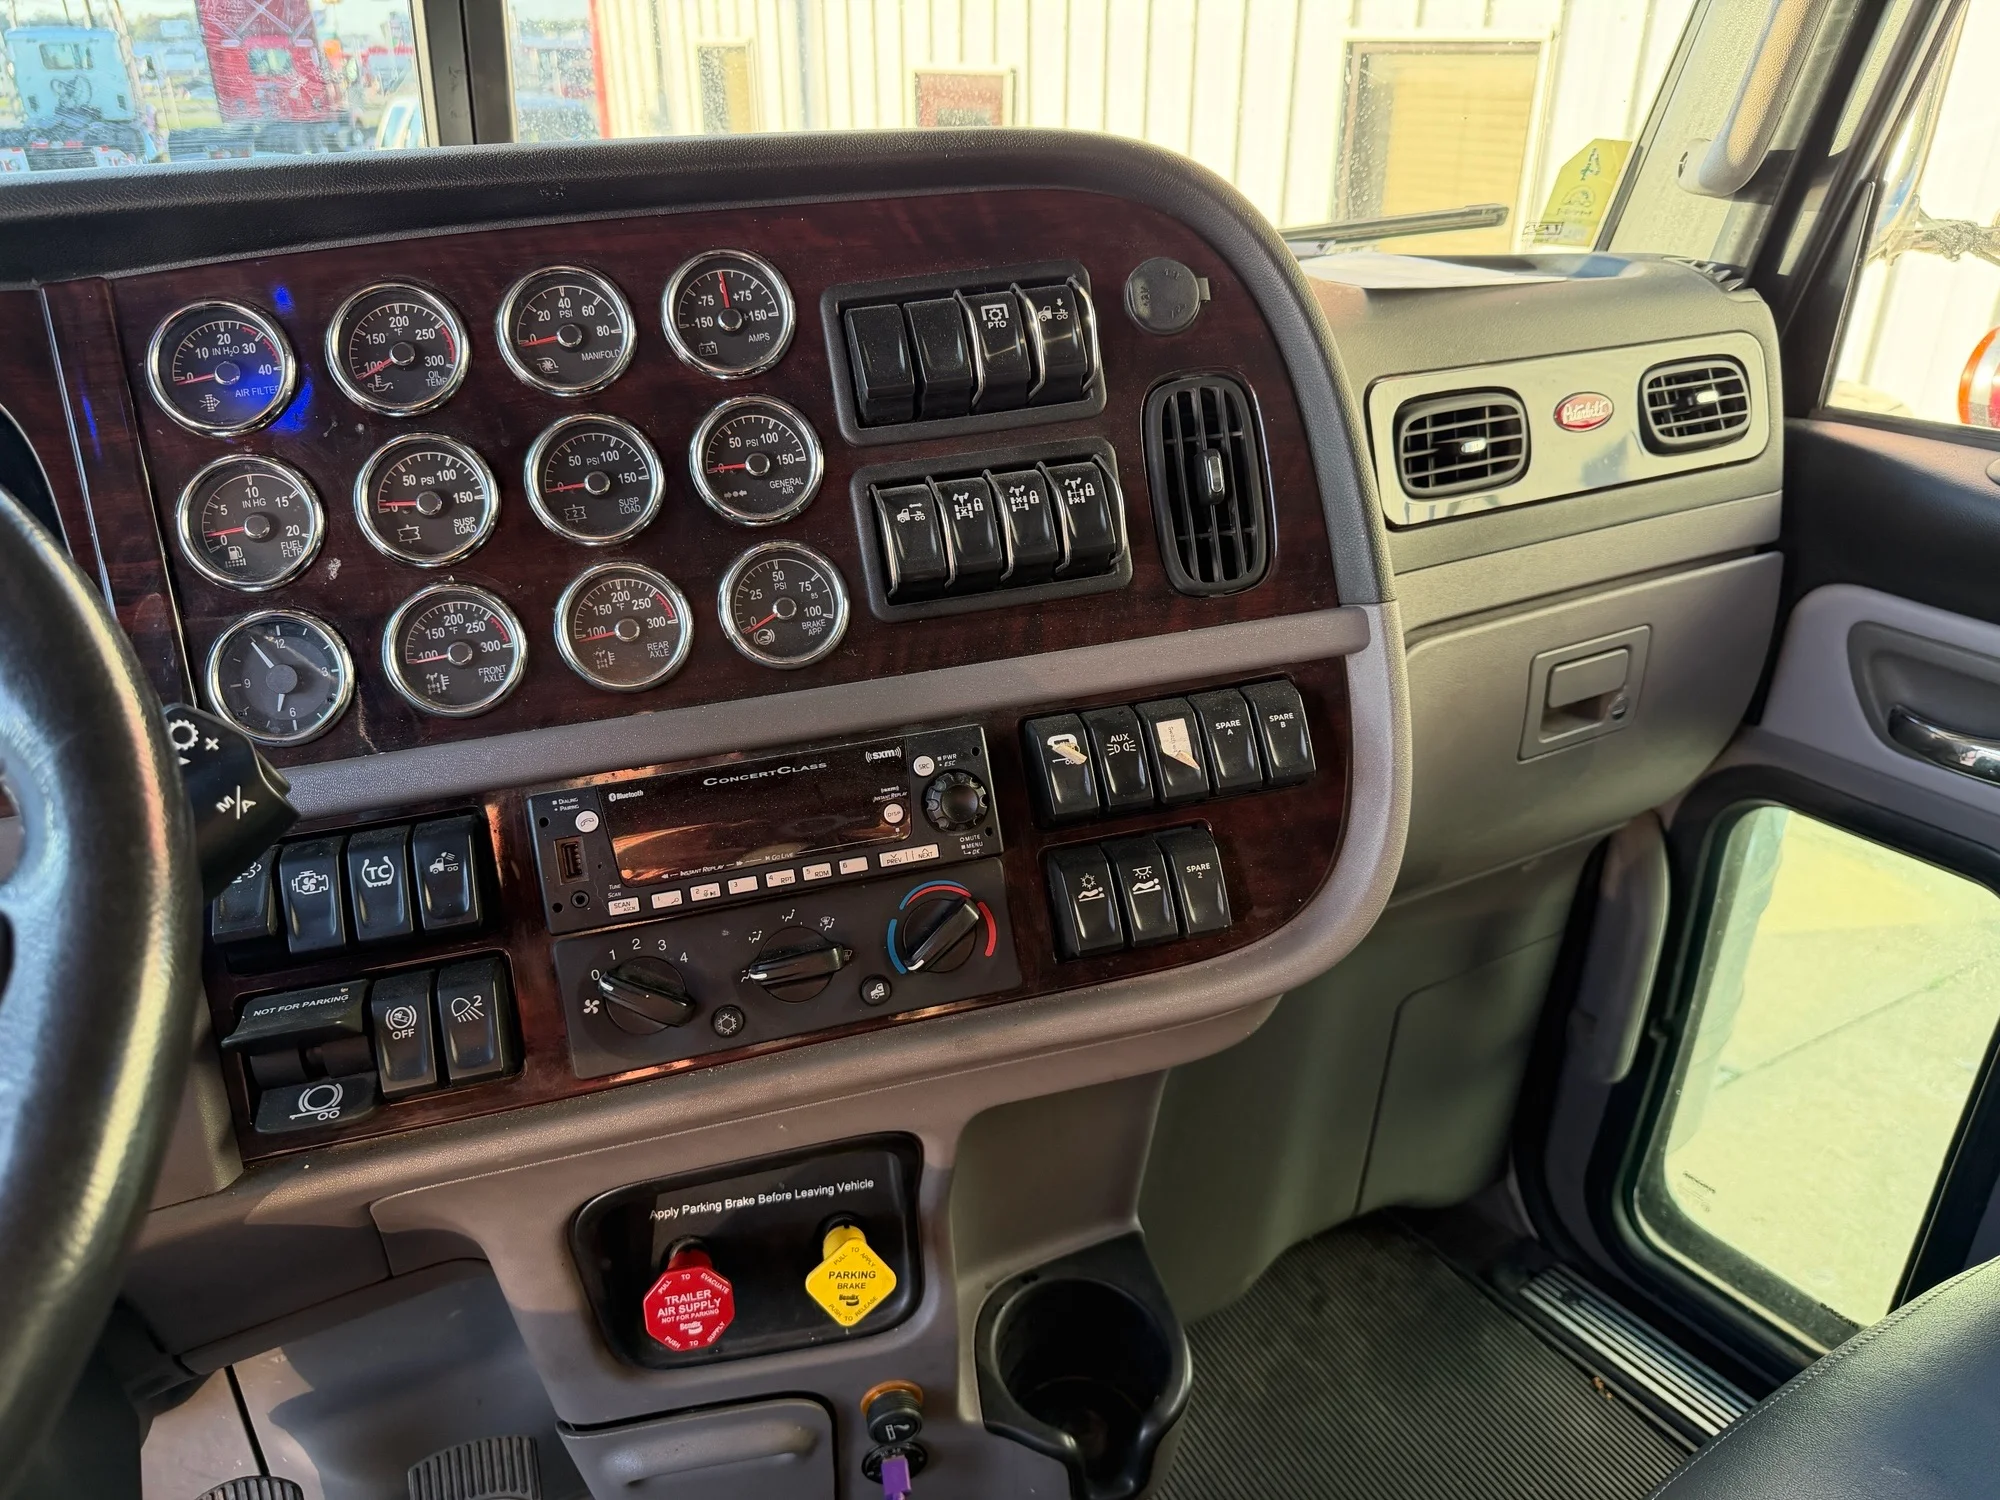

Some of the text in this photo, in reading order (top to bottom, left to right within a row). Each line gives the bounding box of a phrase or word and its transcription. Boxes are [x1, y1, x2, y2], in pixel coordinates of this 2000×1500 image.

[698, 295, 714, 306] -75
[733, 290, 752, 301] +75
[558, 298, 571, 309] 40
[537, 310, 550, 321] 20
[560, 310, 573, 318] PSI
[582, 305, 595, 316] 60
[744, 310, 766, 321] +150
[389, 316, 409, 328] 200
[691, 317, 714, 328] -150
[987, 320, 1007, 329] PTO
[415, 328, 435, 340] 250
[596, 325, 609, 336] 80
[217, 333, 231, 345] 20
[366, 333, 386, 345] 150
[748, 332, 770, 342] AMPS
[195, 347, 208, 359] 10
[212, 346, 222, 356] IN
[242, 343, 256, 354] 30
[581, 349, 620, 361] MANIFOLD
[424, 355, 444, 367] 300
[258, 364, 272, 375] 40
[235, 388, 250, 398] AIR
[729, 437, 741, 448] 50
[746, 439, 759, 447] PSI
[760, 432, 778, 444] 100
[568, 455, 581, 466] 50
[586, 457, 600, 466] PSI
[600, 450, 620, 462] 100
[776, 453, 794, 465] 150
[403, 474, 416, 486] 50
[437, 469, 456, 481] 100
[618, 472, 637, 484] 150
[421, 476, 435, 486] PSI
[770, 477, 804, 489] GENERAL
[245, 487, 259, 498] 10
[782, 486, 795, 495] AIR
[242, 498, 266, 508] IN HG
[275, 496, 289, 508] 15
[453, 491, 473, 504] 150
[618, 496, 639, 507] SUSP
[220, 505, 228, 516] 5
[620, 504, 640, 514] LOAD
[453, 517, 476, 527] SUSP
[286, 525, 300, 536] 20
[454, 525, 477, 535] LOAD
[220, 535, 228, 546] 0
[281, 541, 303, 550] FUEL
[772, 570, 784, 581] 50
[774, 582, 787, 590] PSI
[798, 581, 811, 592] 75
[610, 590, 630, 602] 200
[750, 589, 763, 600] 25
[632, 597, 651, 610] 250
[593, 604, 612, 616] 150
[804, 606, 822, 617] 100
[444, 613, 464, 626] 200
[646, 616, 666, 628] 300
[750, 616, 757, 626] 0
[802, 619, 827, 630] BRAKE
[465, 620, 486, 634] 250
[587, 625, 606, 637] 100
[808, 627, 823, 636] APP
[425, 627, 445, 640] 150
[274, 638, 286, 649] 12
[480, 640, 500, 653] 300
[647, 640, 669, 651] REAR
[418, 649, 438, 660] 100
[649, 649, 670, 658] AXLE
[321, 667, 328, 677] 3
[478, 664, 506, 676] FRONT
[483, 673, 504, 683] AXLE
[244, 679, 251, 689] 9
[289, 707, 296, 717] 6
[1269, 712, 1294, 722] SPARE
[1216, 719, 1241, 729] SPARE
[1110, 733, 1130, 742] AUX
[616, 790, 644, 800] Bluetooth
[366, 864, 390, 879] TC
[1186, 863, 1211, 873] SPARE
[814, 870, 830, 878] RDM
[780, 876, 793, 884] RPT
[632, 938, 642, 950] 2
[658, 939, 667, 950] 3
[609, 950, 616, 960] 1
[680, 952, 688, 963] 4
[591, 969, 600, 981] 0
[253, 994, 349, 1017] NOT FOR PARKING
[474, 995, 482, 1006] 2
[392, 1028, 415, 1040] OFF
[650, 1178, 874, 1220] Apply Parking Brake Before Leaving Vehicle
[834, 1254, 848, 1265] PULL
[860, 1252, 876, 1267] APPLY
[829, 1270, 876, 1280] PARKING
[658, 1280, 672, 1294] PULL
[701, 1272, 729, 1294] EVACUATE
[665, 1289, 711, 1305] TRAILER
[657, 1298, 721, 1318] AIR SUPPLY
[829, 1304, 842, 1316] PUSH
[855, 1296, 878, 1317] RELEASE
[690, 1309, 719, 1319] PARKING
[665, 1336, 681, 1349] PUSH
[707, 1321, 725, 1343] SUPPLY
